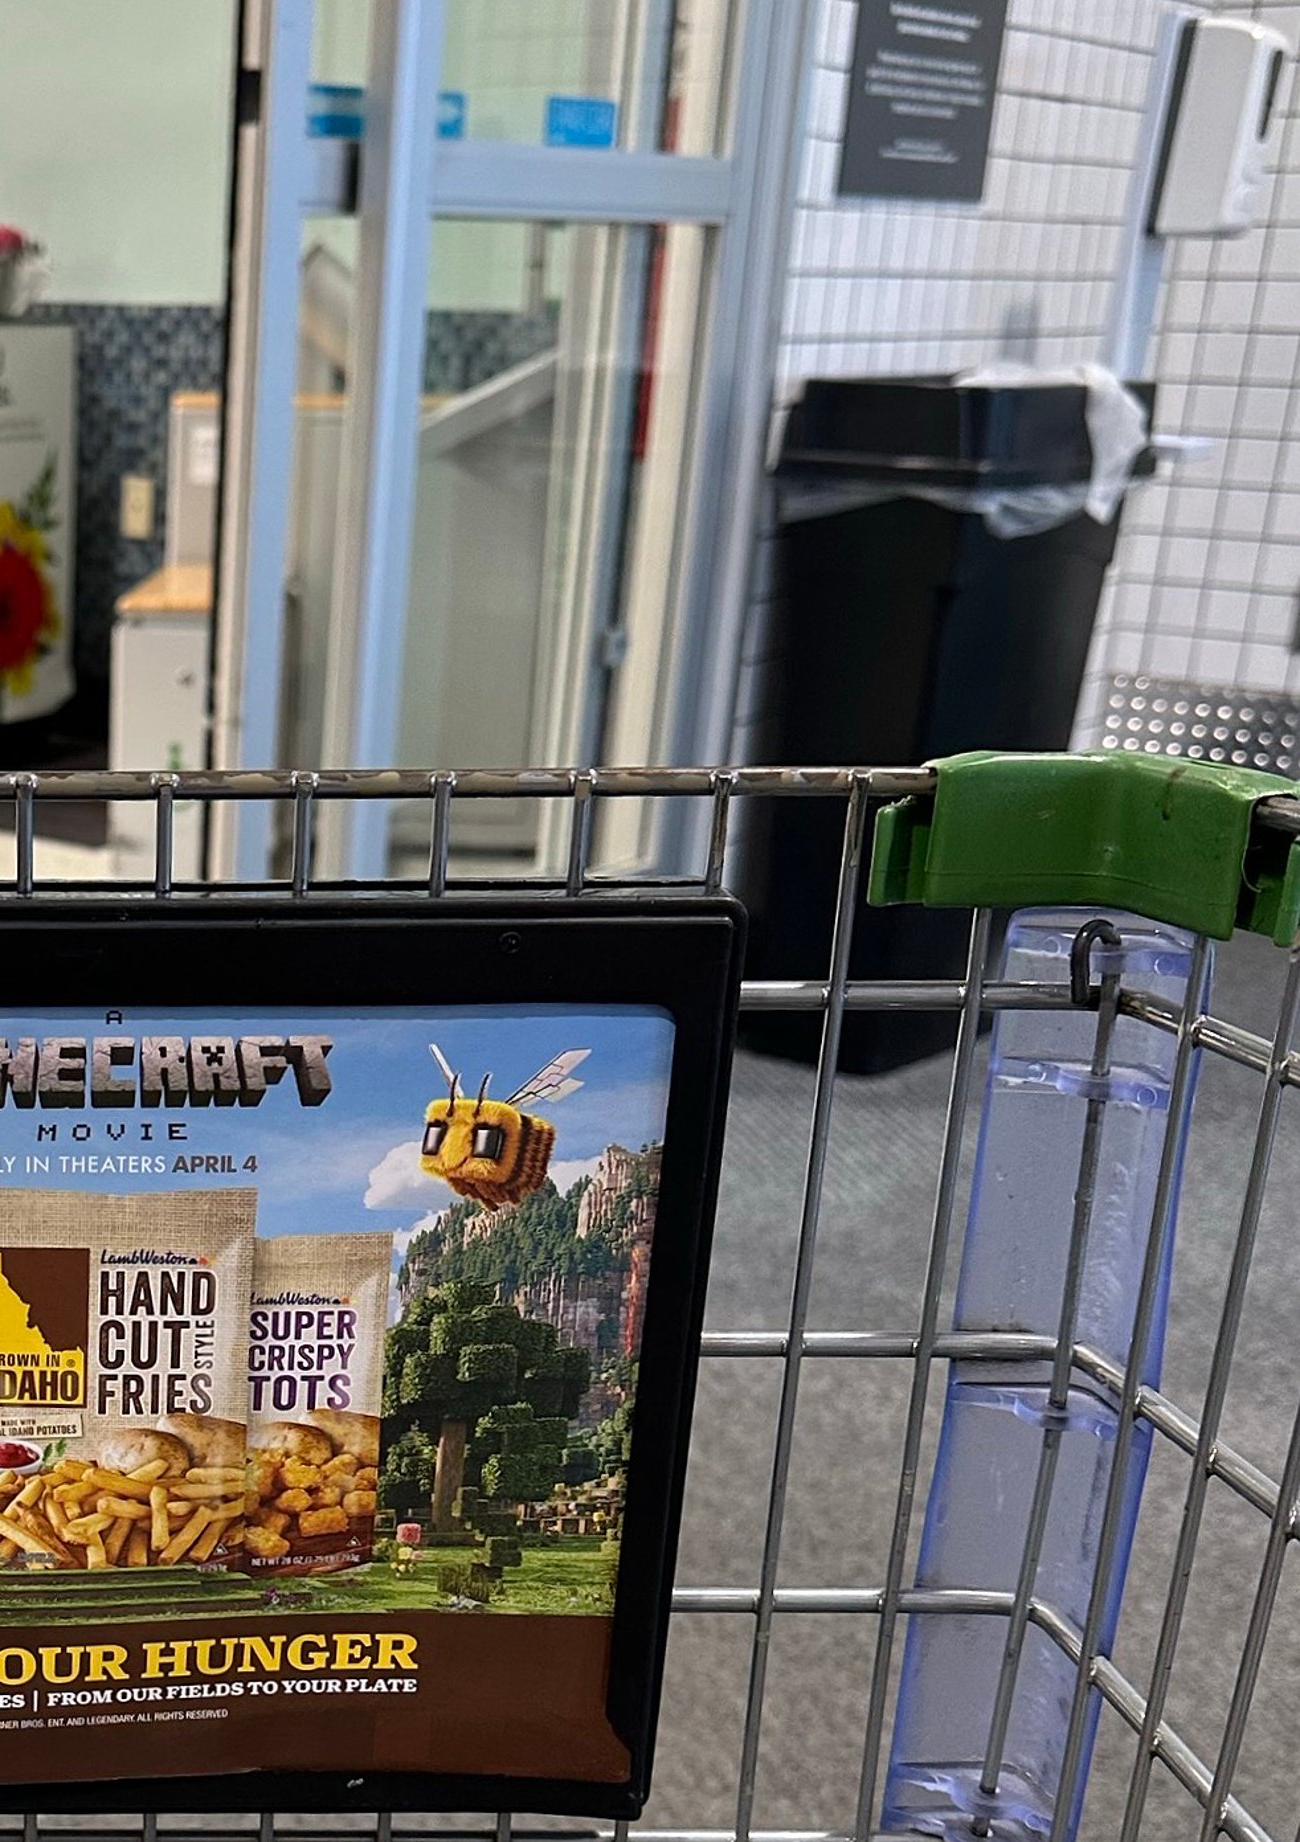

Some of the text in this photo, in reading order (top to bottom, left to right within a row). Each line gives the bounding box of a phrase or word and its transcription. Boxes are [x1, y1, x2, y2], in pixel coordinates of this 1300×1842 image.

[106, 1010, 123, 1025] A
[37, 1122, 188, 1142] MOVIE
[25, 1156, 49, 1173] IN
[59, 1155, 167, 1174] THEATERS
[172, 1155, 237, 1174] APRIL
[241, 1156, 258, 1173] 4
[99, 1270, 217, 1316] HAND
[249, 1309, 357, 1341] SUPER
[98, 1319, 191, 1370] CUT
[193, 1319, 216, 1370] STYLE
[248, 1343, 356, 1372] CRISPY
[45, 1354, 61, 1367] IN
[97, 1373, 213, 1415] FRIES
[247, 1373, 352, 1411] TOTS
[8, 1426, 34, 1436] IDAHO
[36, 1424, 77, 1435] POTATOES
[140, 1633, 419, 1680] HUNGER
[46, 1677, 418, 1708] FROM OUR FIELDS TO YOUR PLATE
[66, 1716, 85, 1726] AND
[137, 1712, 152, 1722] ALL
[154, 1710, 185, 1721] RIGHTS
[185, 1708, 229, 1720] RESERVED
